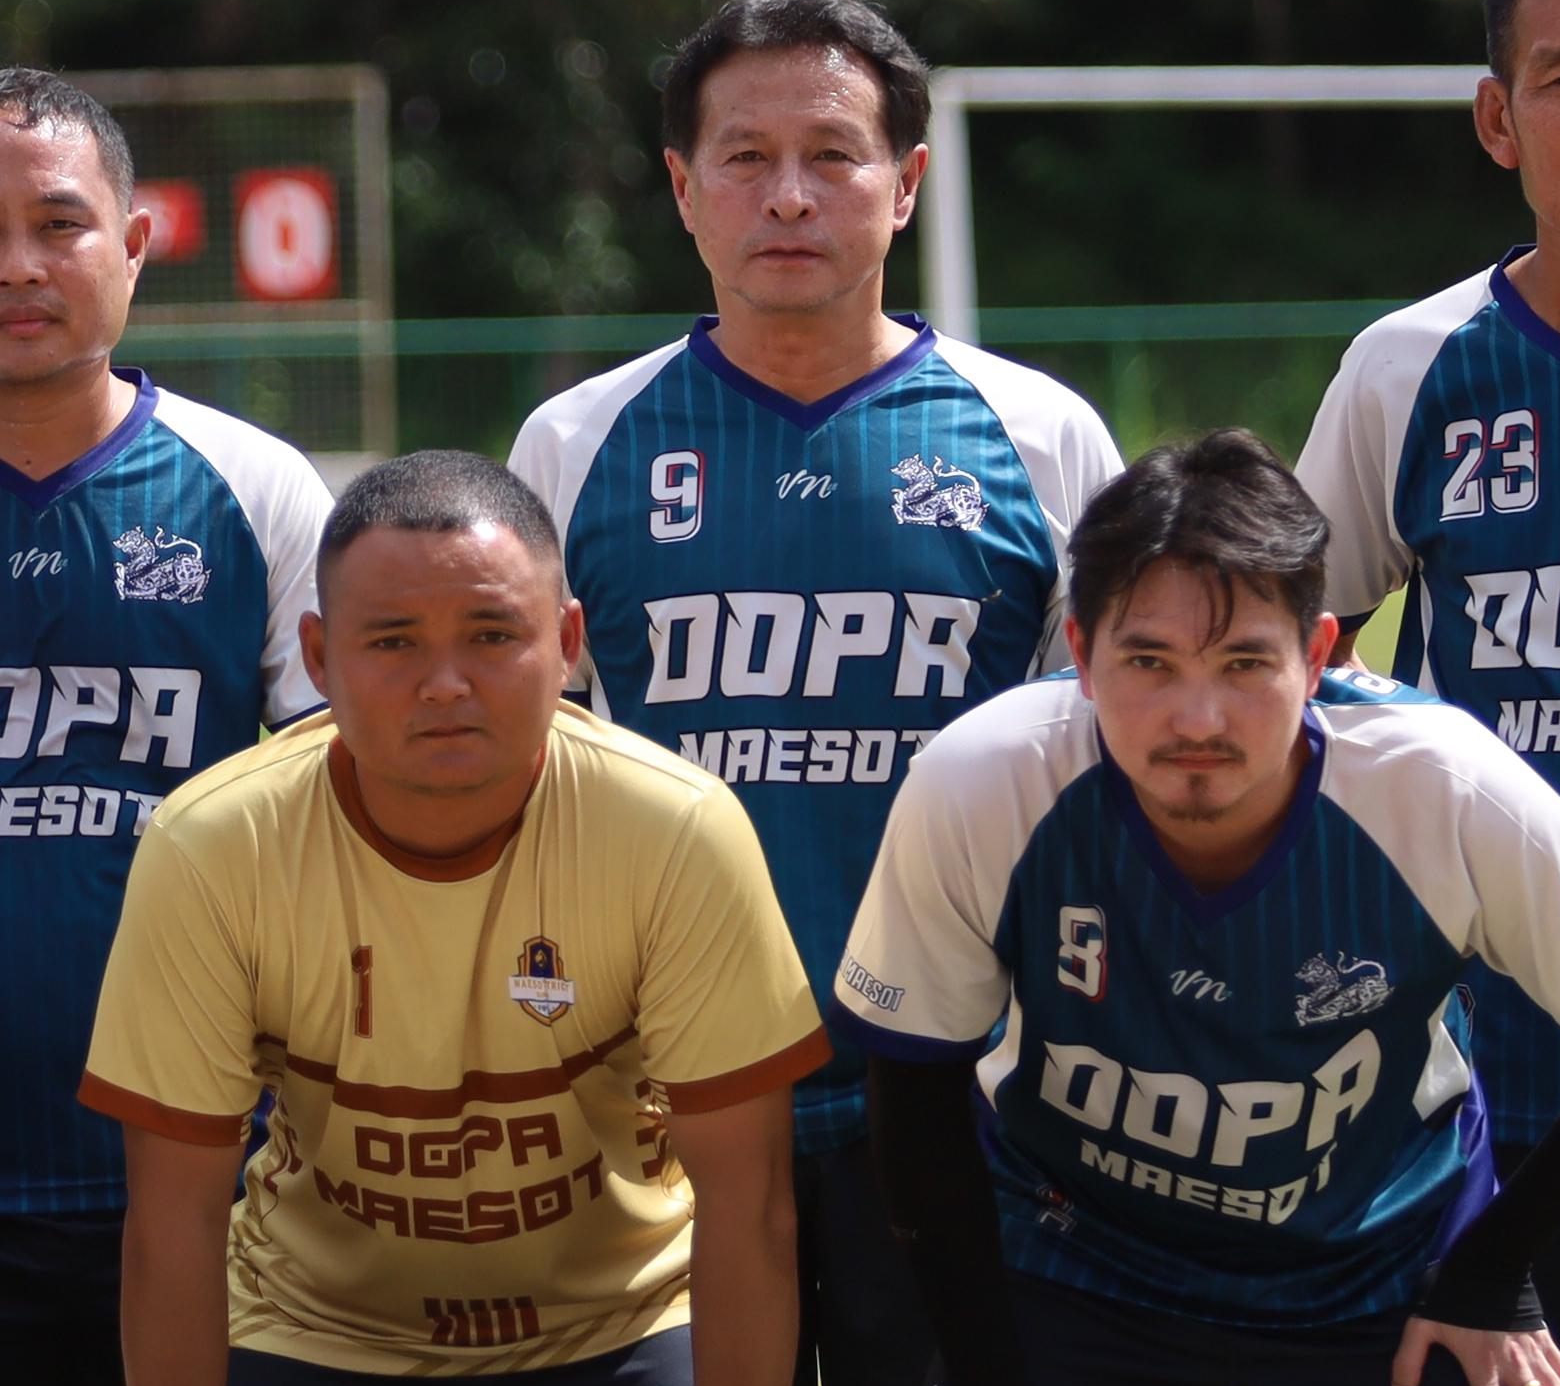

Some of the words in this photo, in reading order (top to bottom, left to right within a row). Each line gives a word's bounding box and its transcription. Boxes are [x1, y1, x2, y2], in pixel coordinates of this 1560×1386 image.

[239, 177, 335, 296] 0
[648, 447, 706, 543] 9
[1439, 407, 1540, 522] 23
[644, 590, 981, 704] DOPA
[351, 945, 373, 1039] 1
[1038, 1028, 1384, 1166] DOPA
[313, 1149, 603, 1246] MAESOT
[1081, 1139, 1341, 1226] MAESOT
